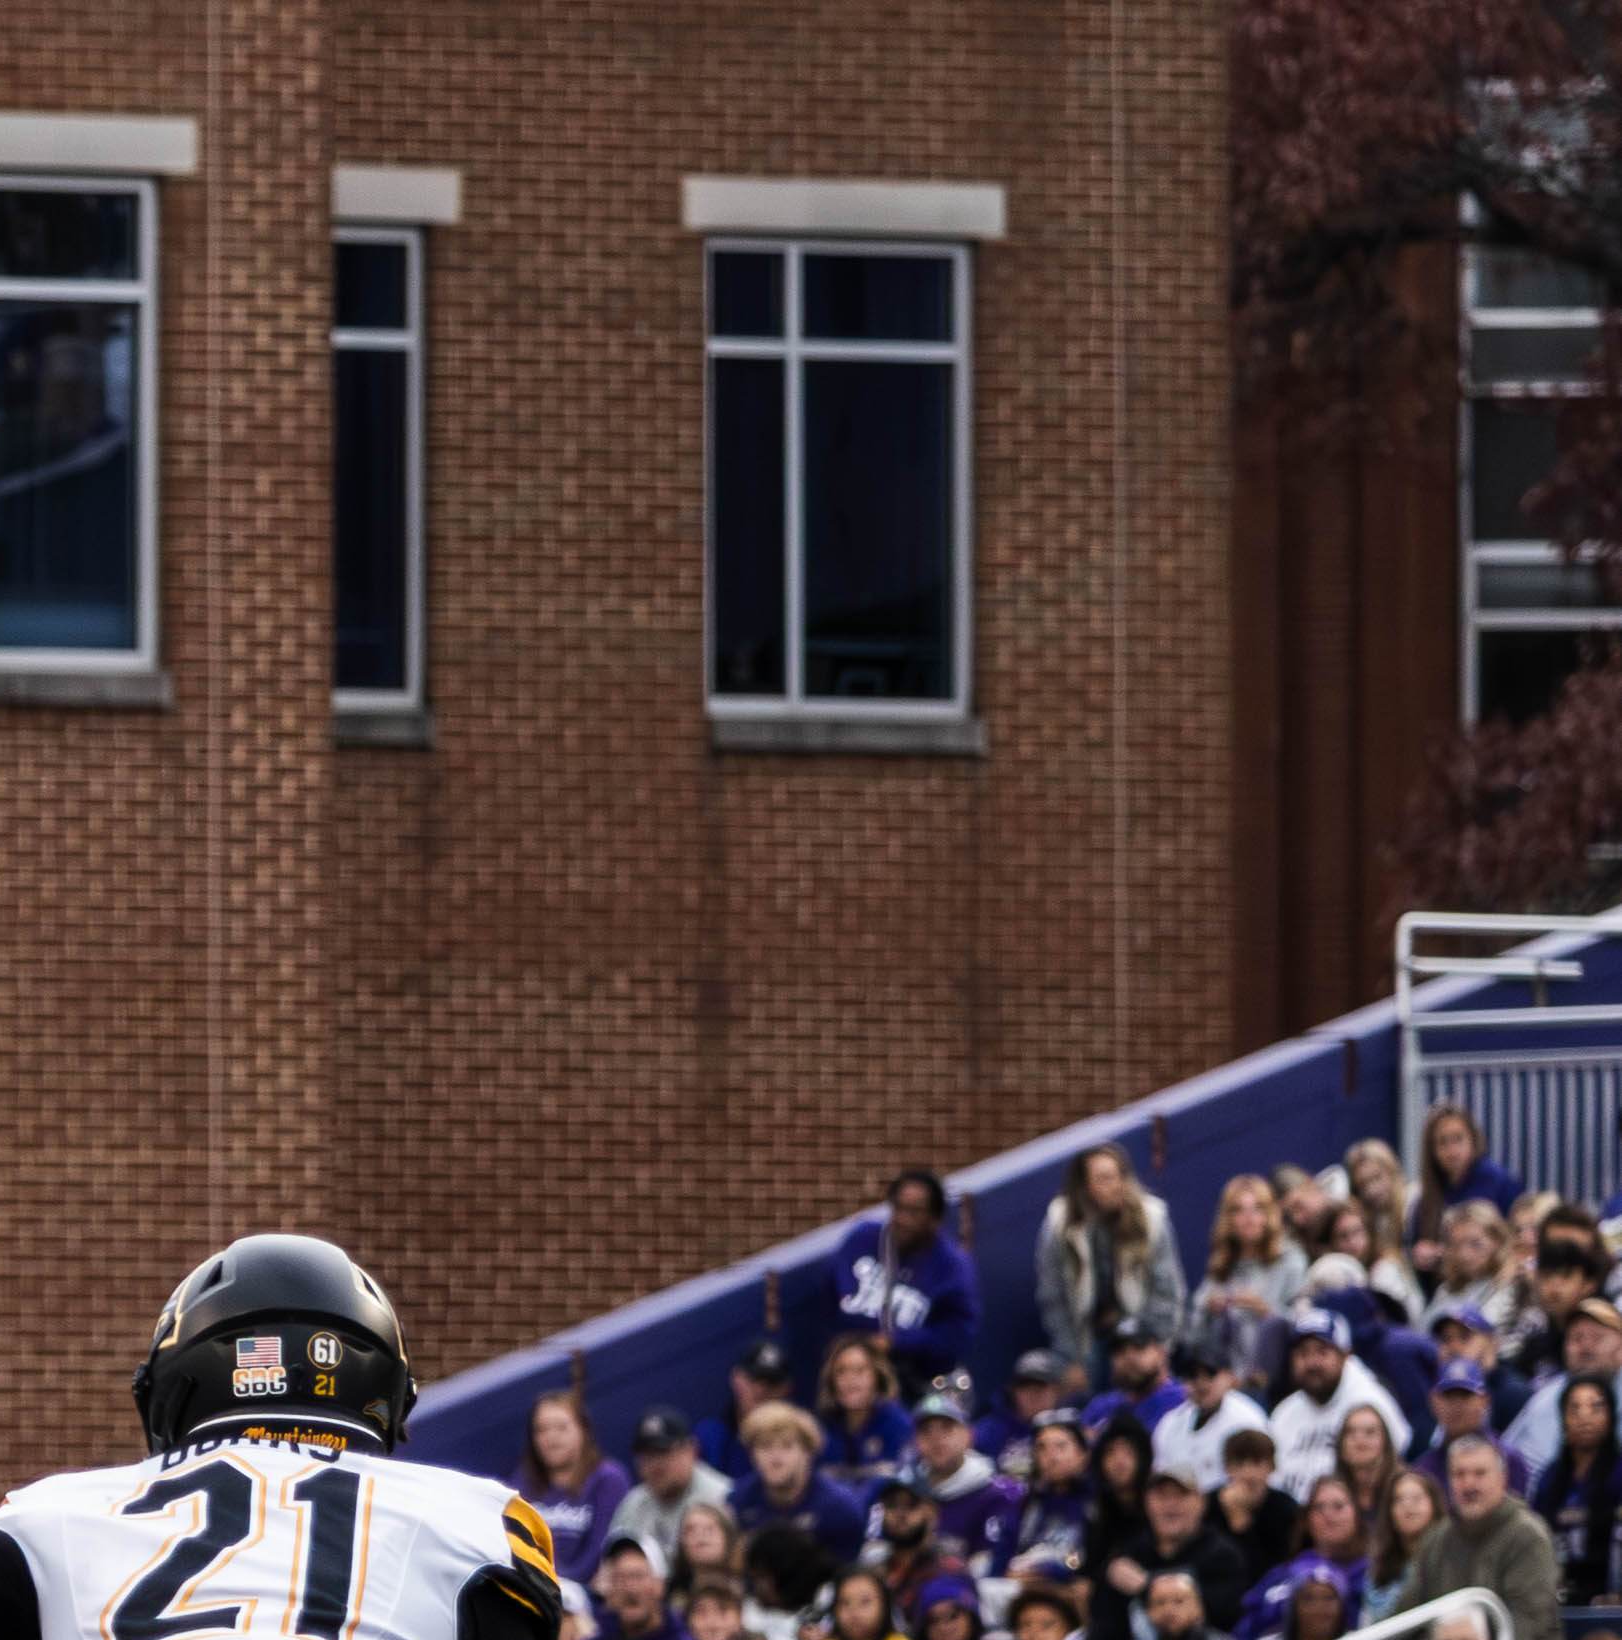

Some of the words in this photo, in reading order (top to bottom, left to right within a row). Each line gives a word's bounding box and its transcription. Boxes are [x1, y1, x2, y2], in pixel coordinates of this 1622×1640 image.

[314, 1337, 337, 1365] 61
[232, 1365, 288, 1398] SBC
[313, 1374, 336, 1397] 21
